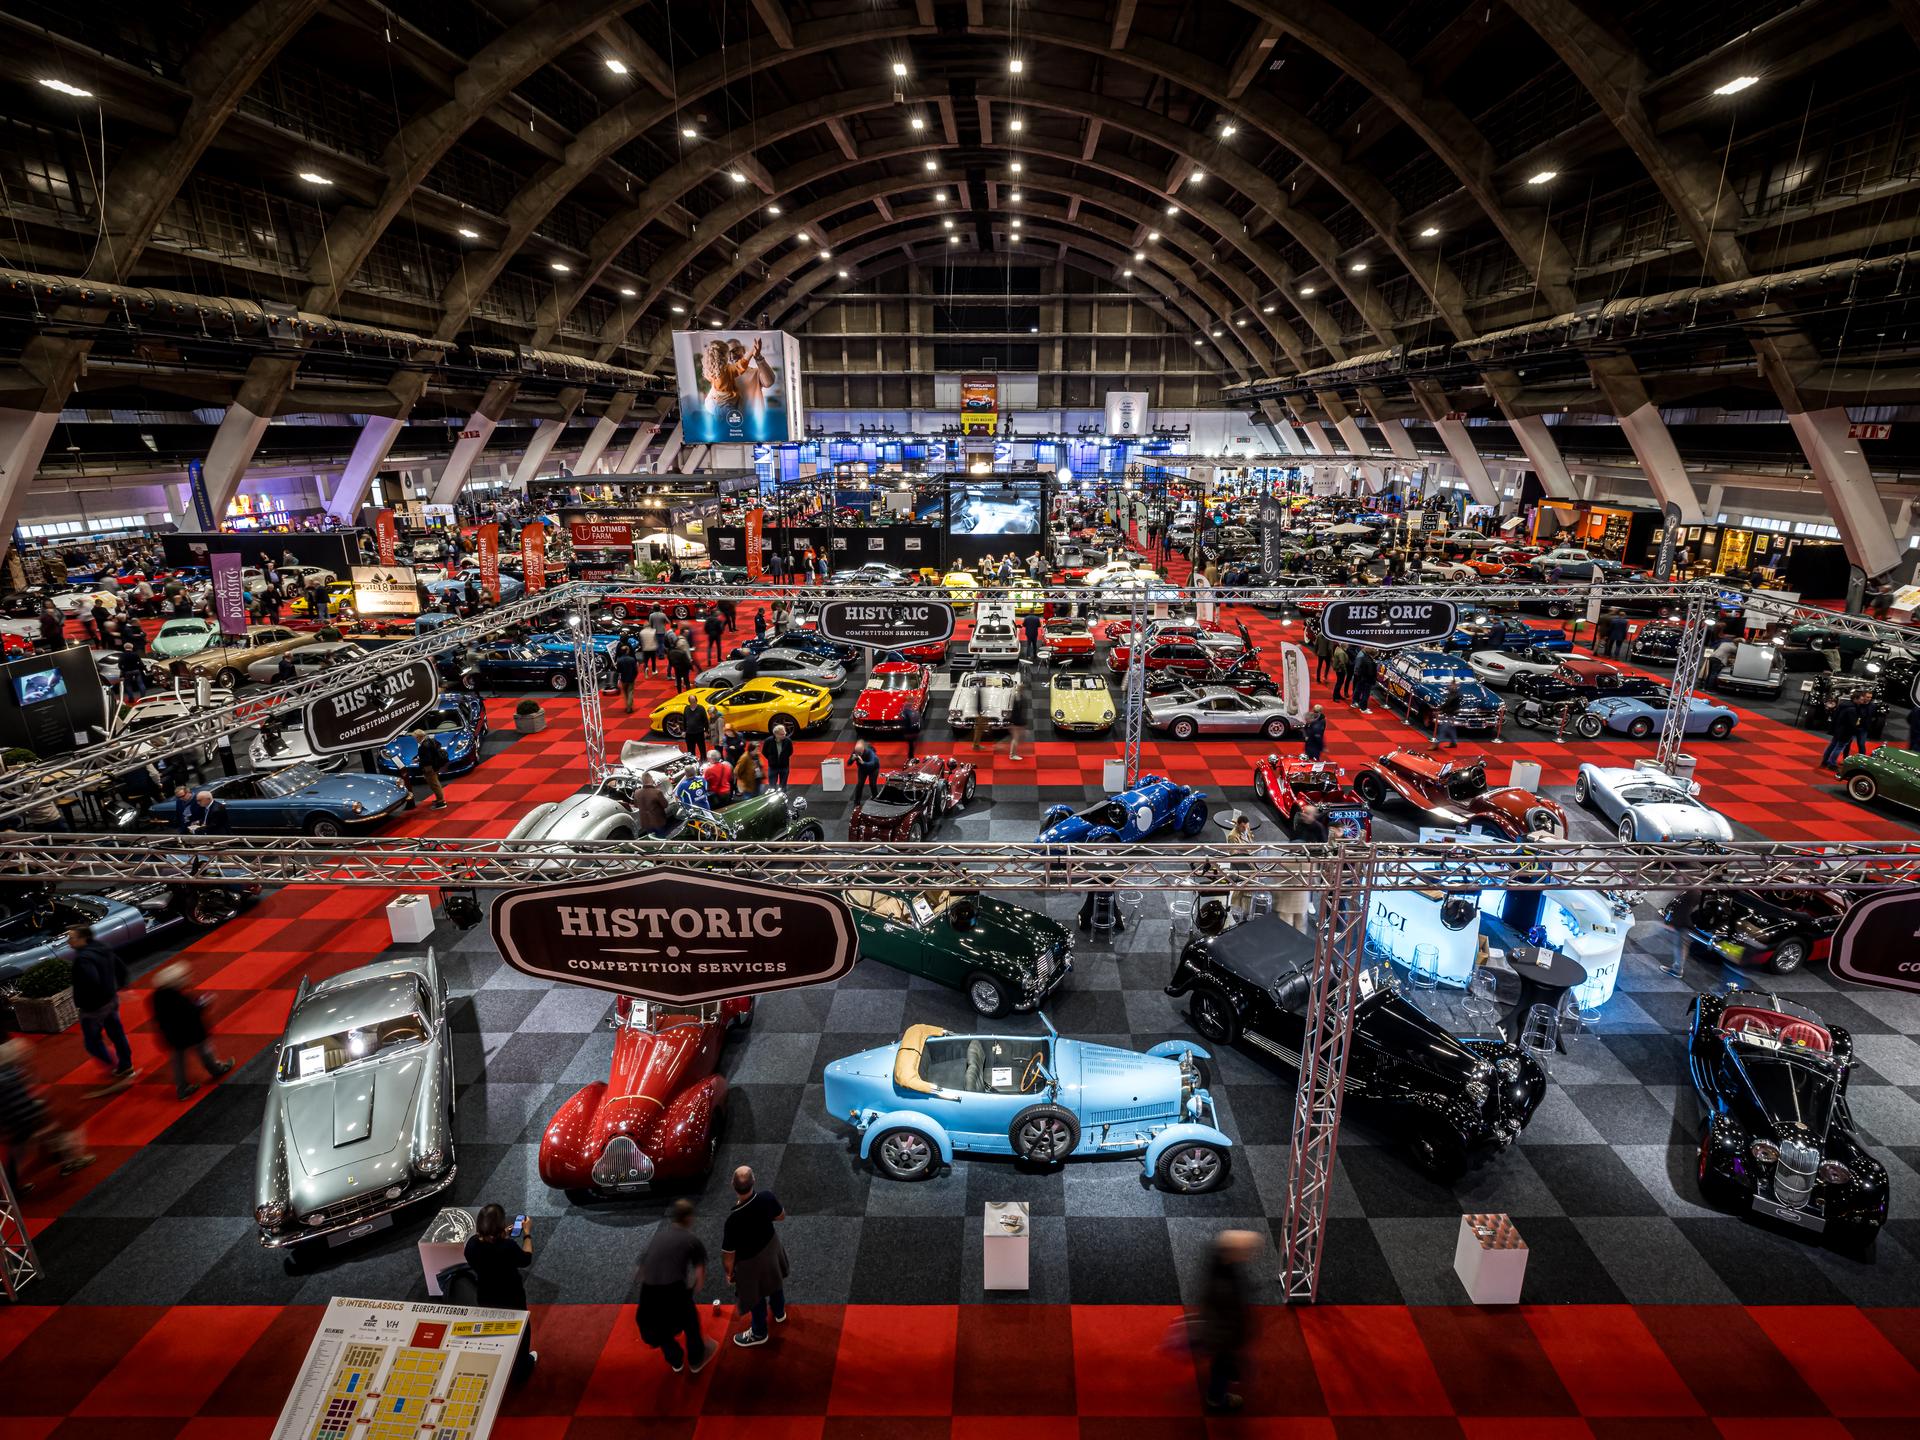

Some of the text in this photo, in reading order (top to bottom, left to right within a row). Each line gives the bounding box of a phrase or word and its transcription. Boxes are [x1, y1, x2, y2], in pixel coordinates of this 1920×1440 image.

[378, 523, 386, 557] OLDTIMER
[480, 538, 488, 576] OLDTIMER
[525, 538, 533, 576] OLDTIMER
[1347, 605, 1433, 619] HISORIC
[339, 700, 420, 741] COMPETITION SERVICES
[557, 906, 783, 938] HISTORIC
[1376, 901, 1407, 932] DCI
[567, 959, 787, 973] COMPETITION SERVICES
[1596, 963, 1615, 978] DCI
[411, 1304, 469, 1316] BEURSPLATTEGROND
